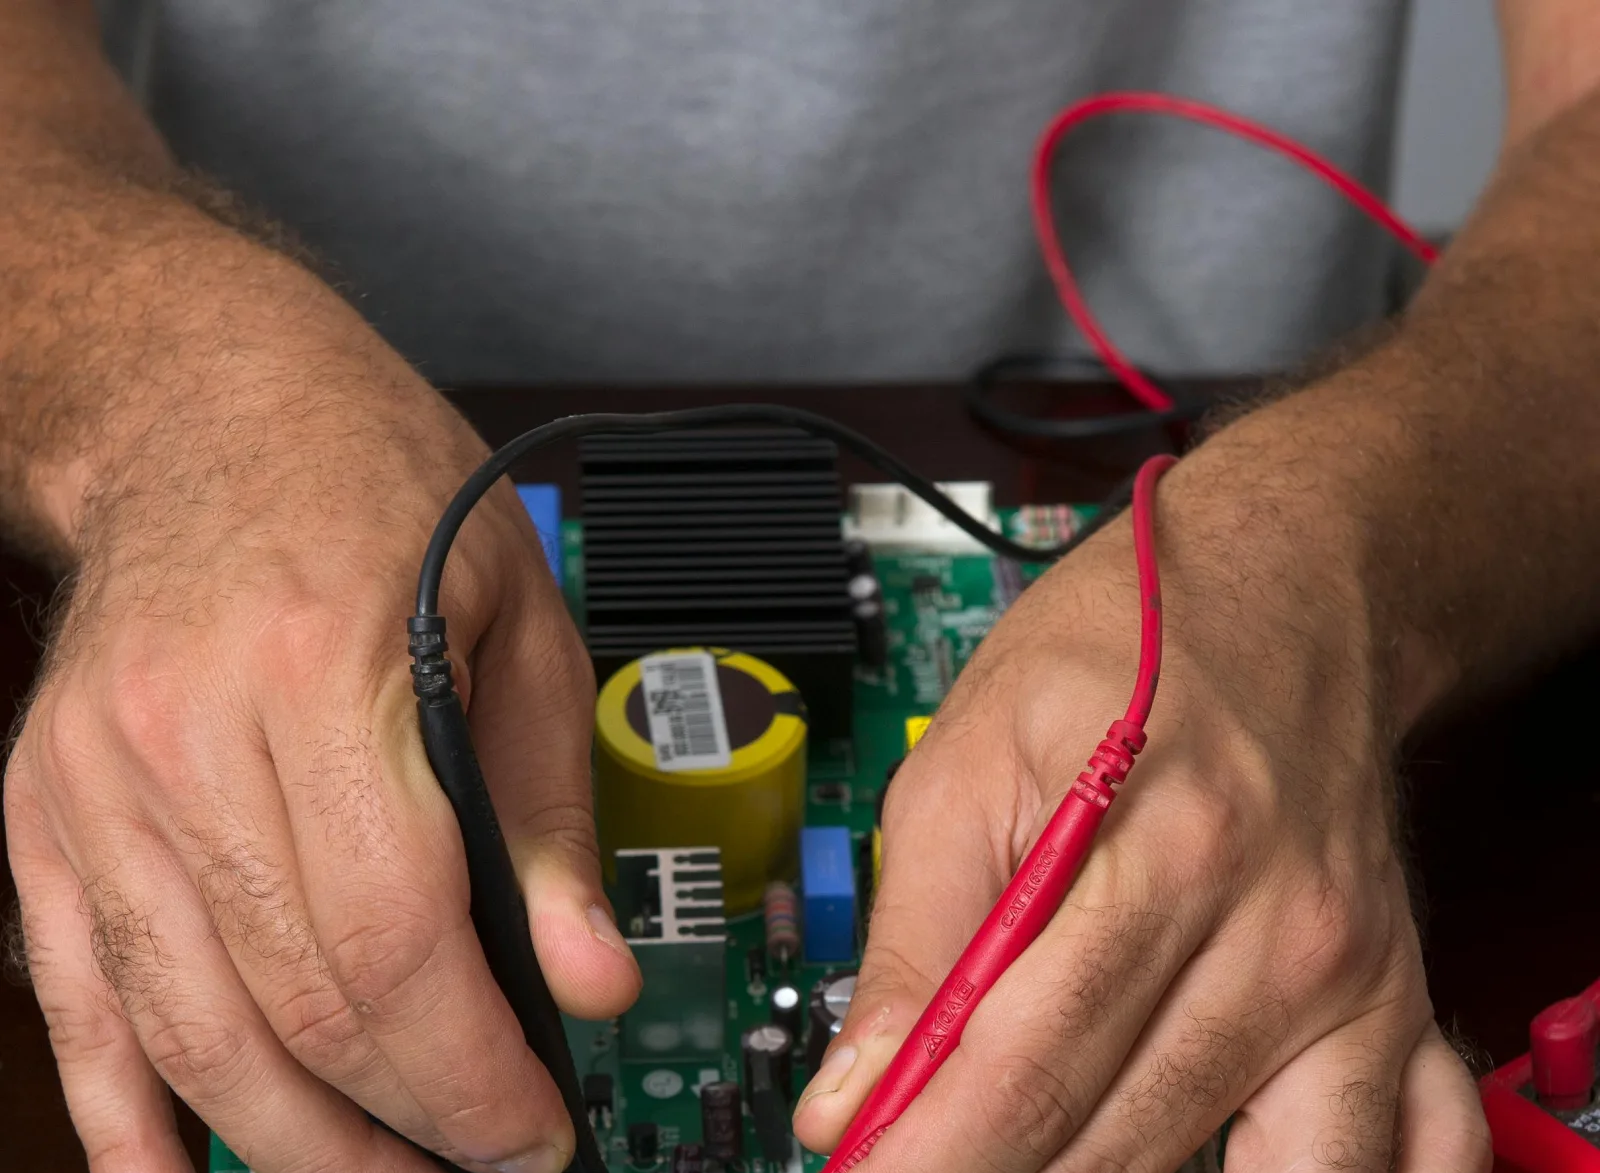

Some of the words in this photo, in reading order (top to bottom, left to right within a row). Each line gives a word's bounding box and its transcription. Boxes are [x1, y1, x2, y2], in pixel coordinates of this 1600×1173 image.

[1001, 893, 1027, 929] CAT
[1029, 842, 1059, 885] 600V
[935, 1001, 964, 1032] 10A
